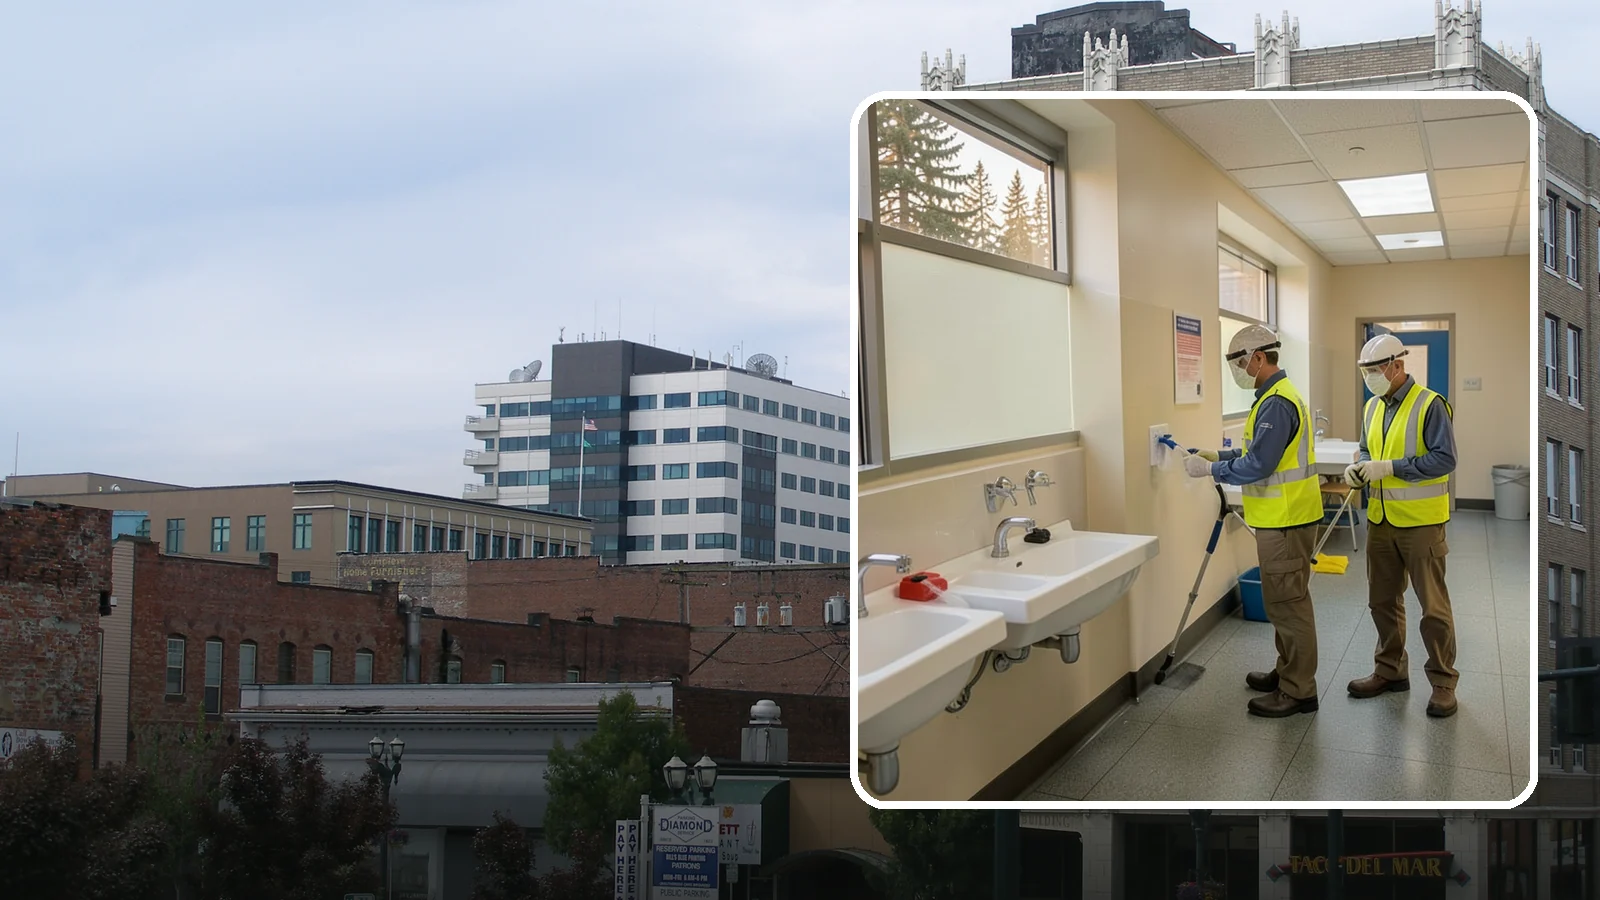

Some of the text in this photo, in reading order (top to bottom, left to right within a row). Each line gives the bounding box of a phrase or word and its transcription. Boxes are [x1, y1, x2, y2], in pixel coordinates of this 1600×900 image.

[660, 818, 713, 832] DIAMOND
[1021, 814, 1071, 828] BUILDING
[617, 825, 625, 853] PAY
[628, 825, 637, 853] PAY
[656, 845, 688, 853] RESERVED
[671, 862, 701, 870] PATRONS
[1346, 856, 1385, 876] DEL
[1392, 857, 1442, 877] MAR
[617, 856, 625, 894] HERE
[628, 856, 637, 894] HERE
[660, 889, 711, 899] PUBLIC PARKING
